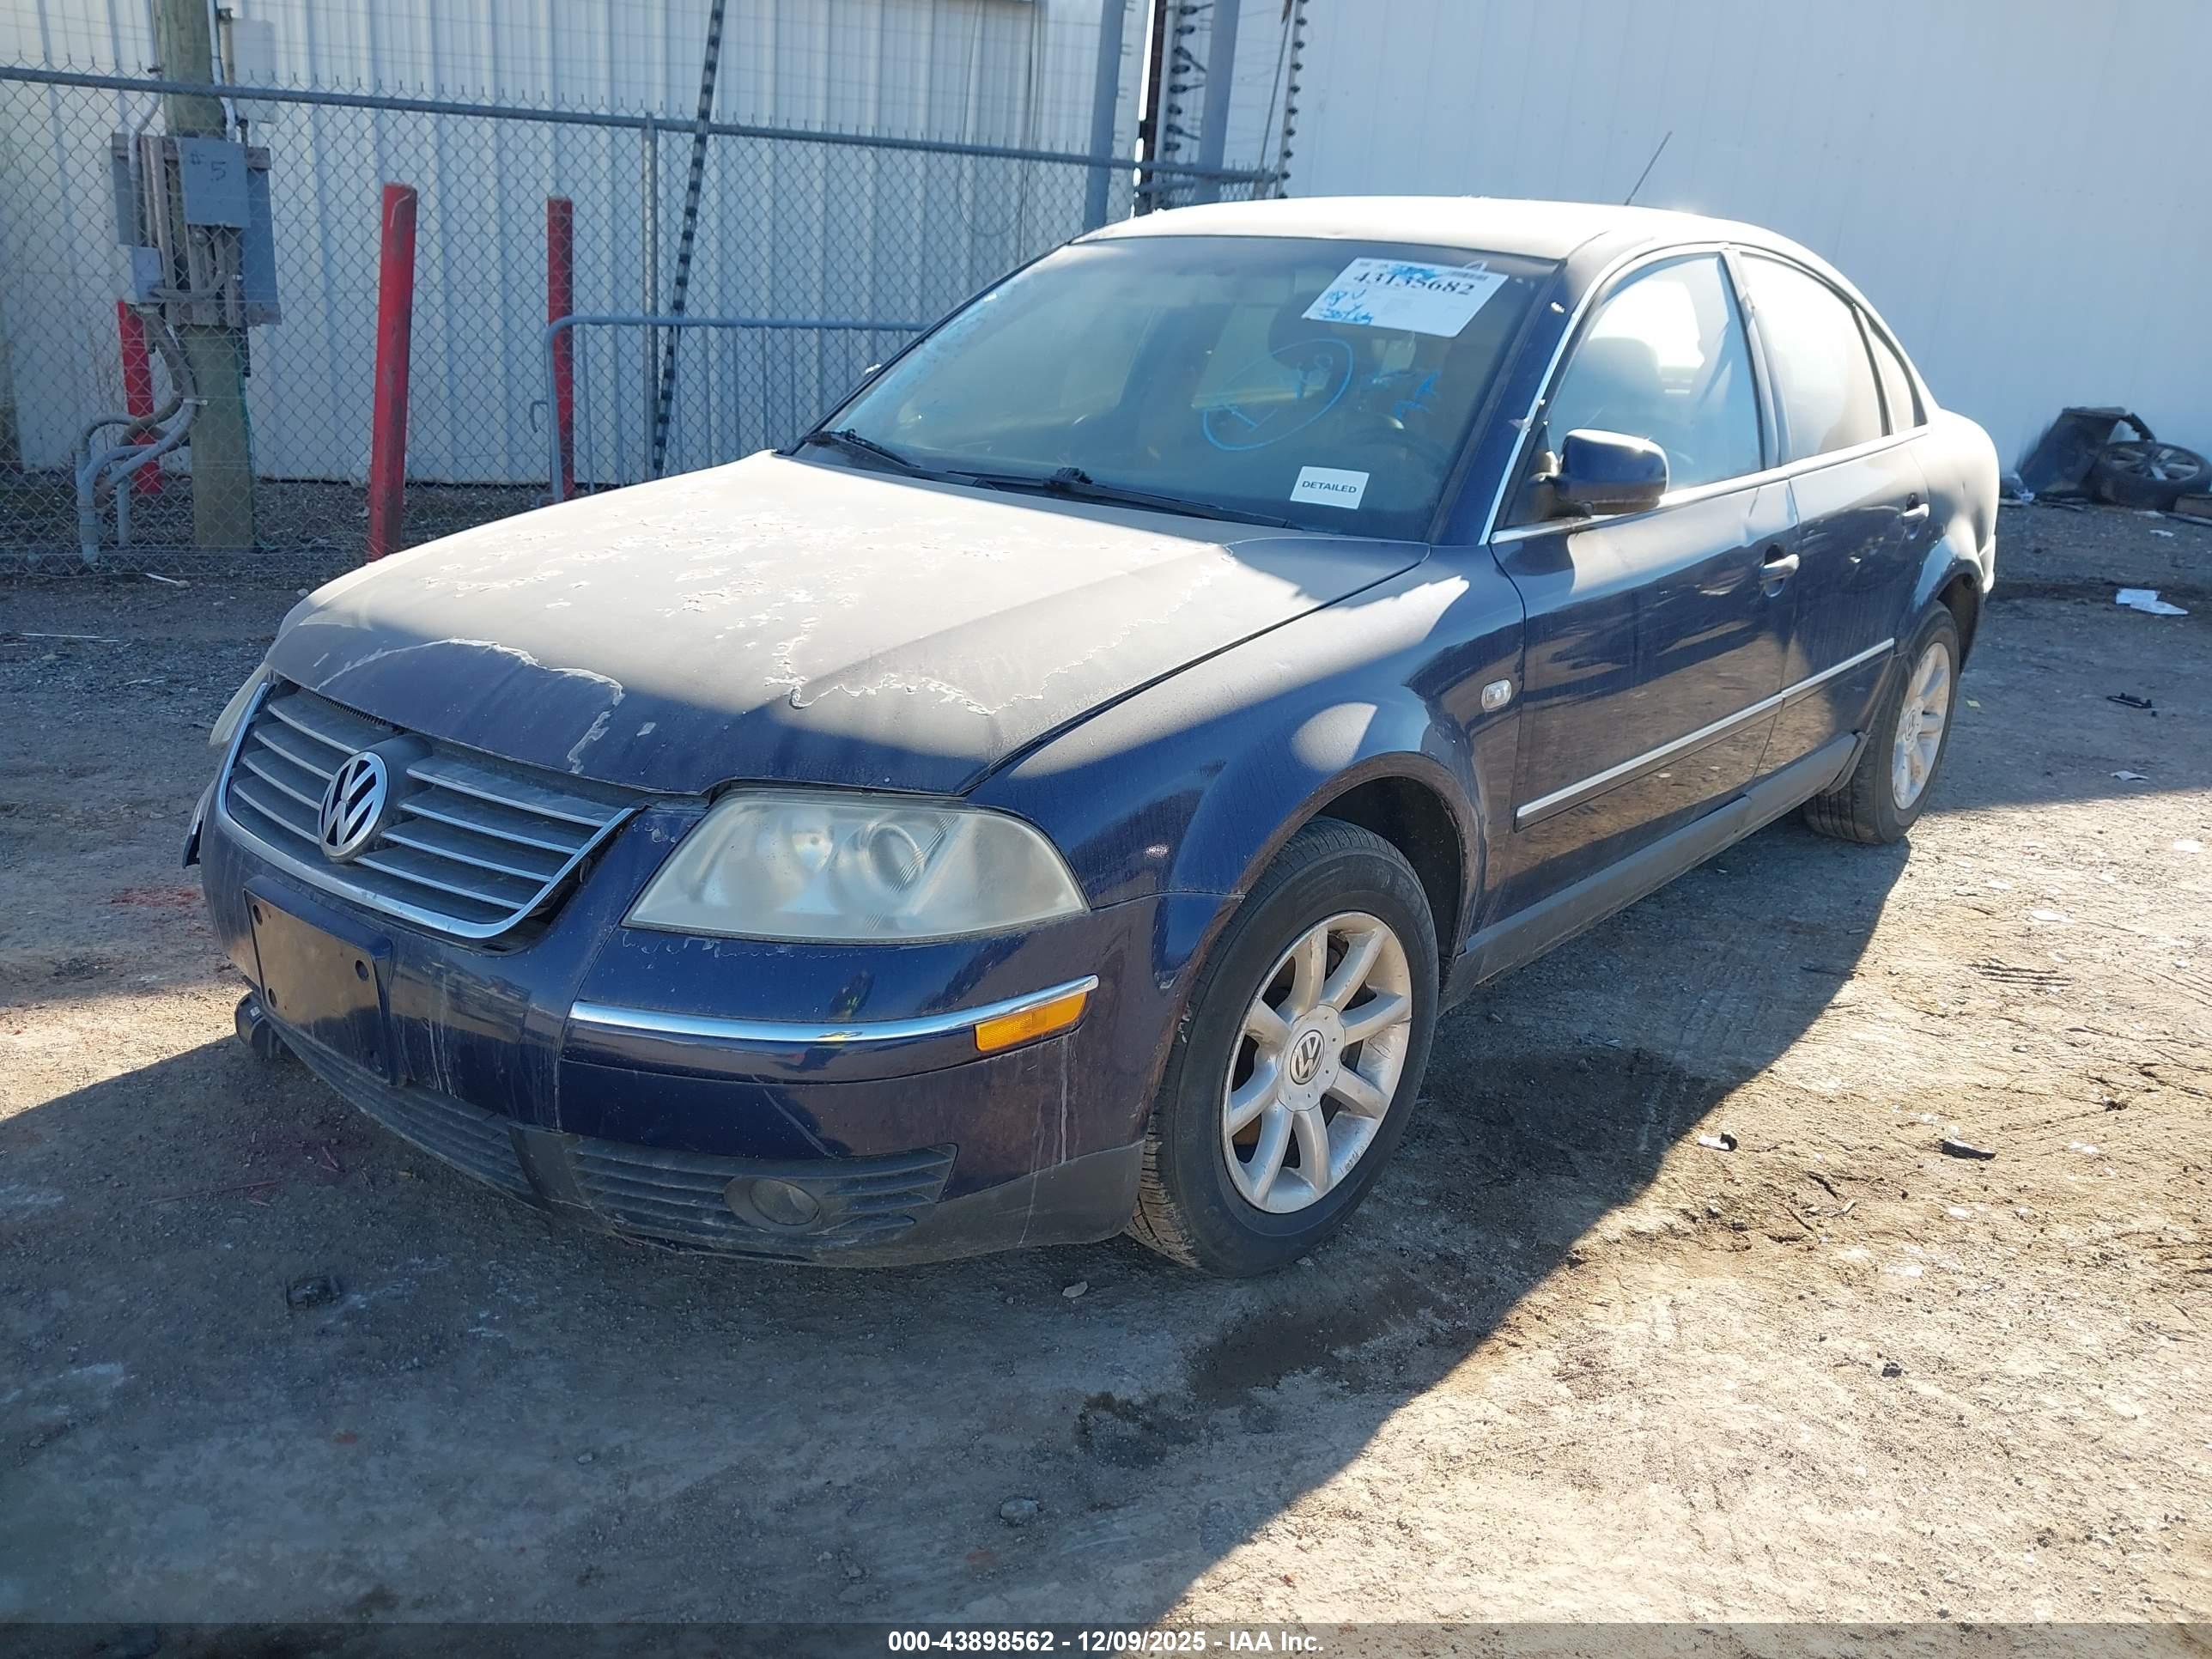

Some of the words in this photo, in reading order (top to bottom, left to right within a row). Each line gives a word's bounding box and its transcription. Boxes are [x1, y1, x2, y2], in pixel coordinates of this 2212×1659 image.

[1302, 481, 1357, 493] DETAILED
[319, 751, 388, 857] VW
[1291, 1030, 1325, 1084] VW
